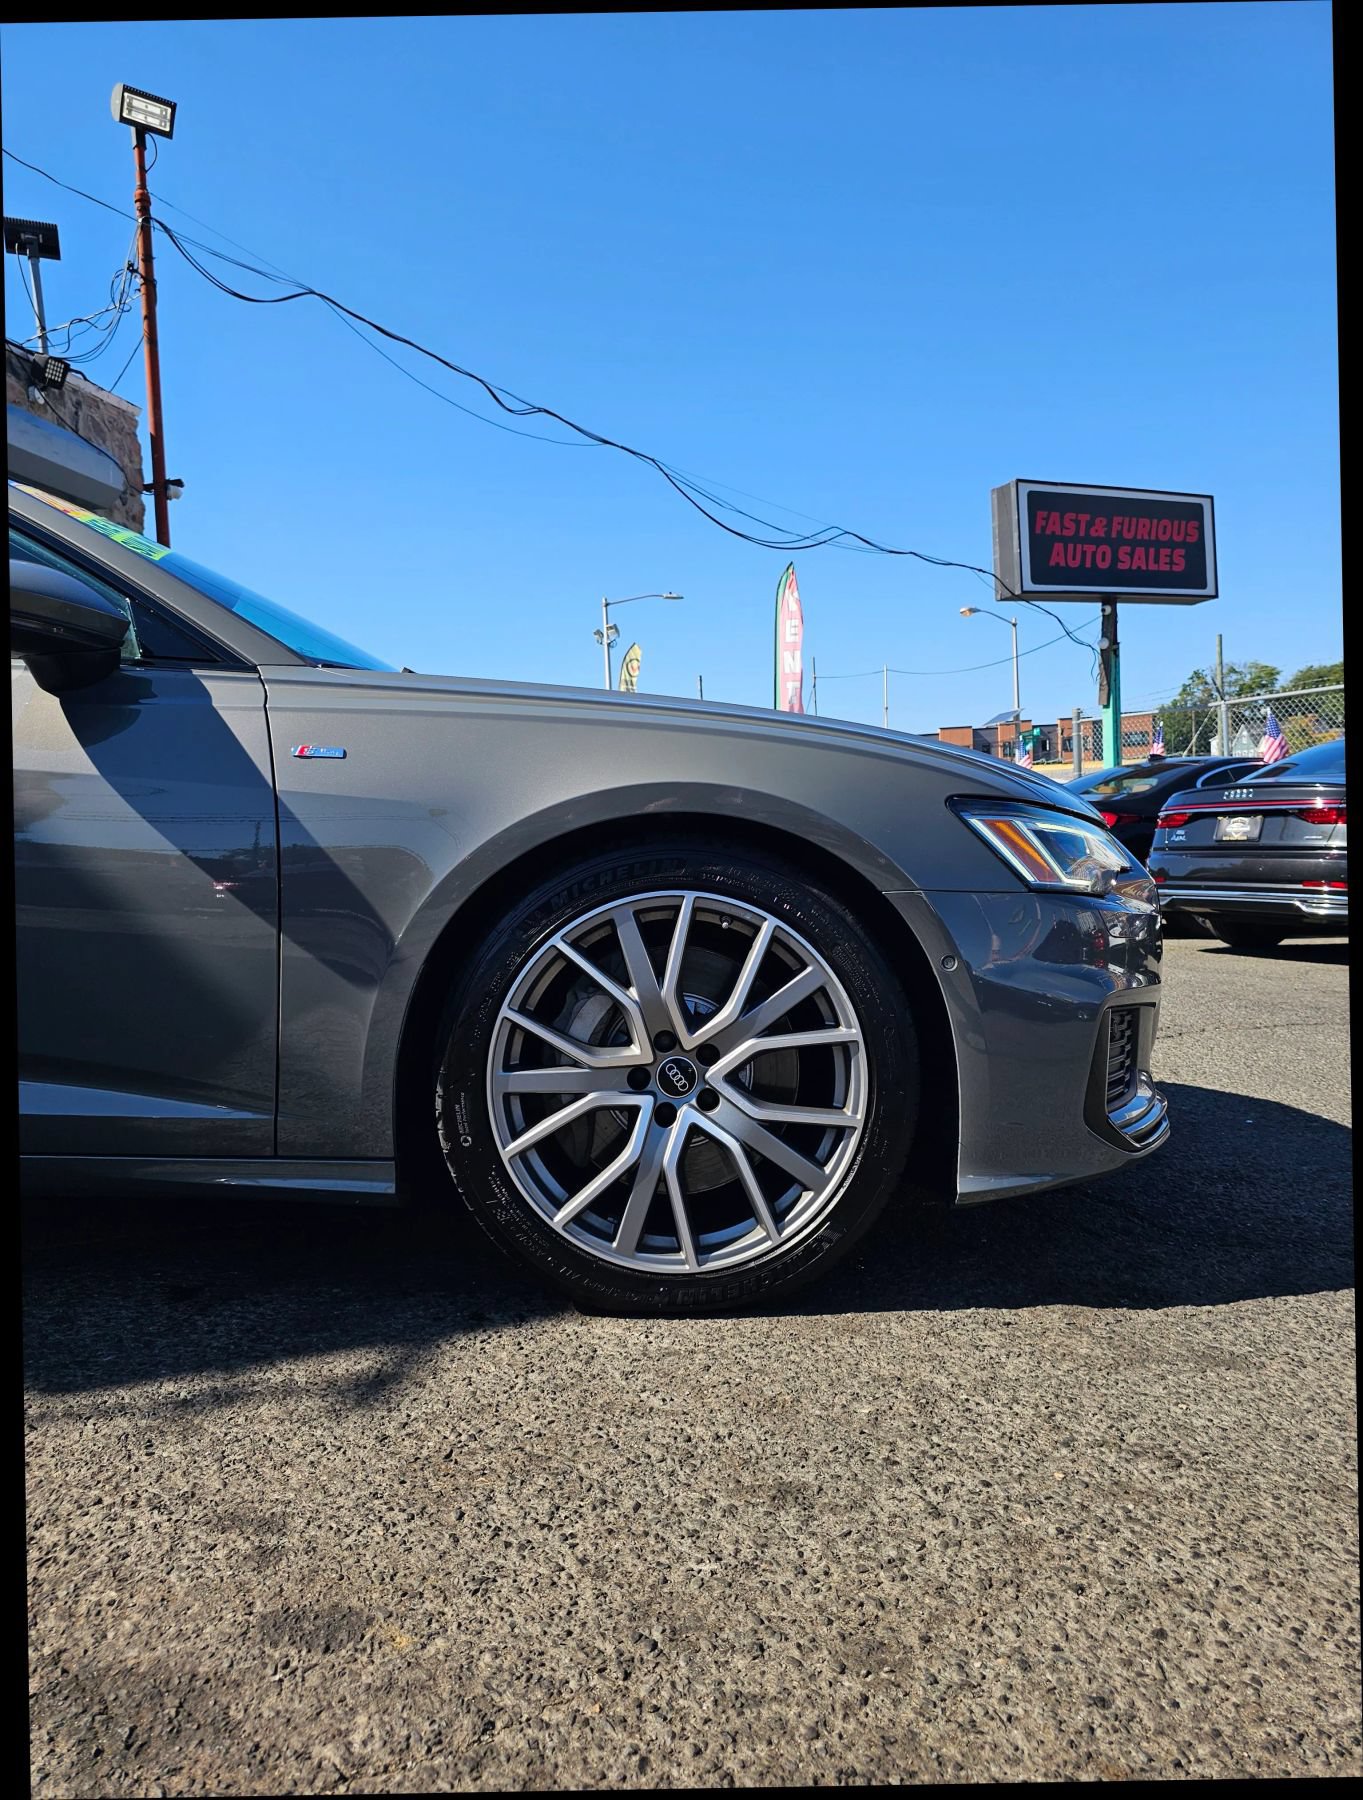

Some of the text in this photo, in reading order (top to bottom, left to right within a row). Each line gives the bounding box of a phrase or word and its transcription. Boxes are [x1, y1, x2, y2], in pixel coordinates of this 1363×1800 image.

[1034, 511, 1090, 538] FAST
[1111, 516, 1199, 543] FURIOUS
[1049, 542, 1186, 572] AUTO SALES
[549, 858, 681, 910] MICHELIN
